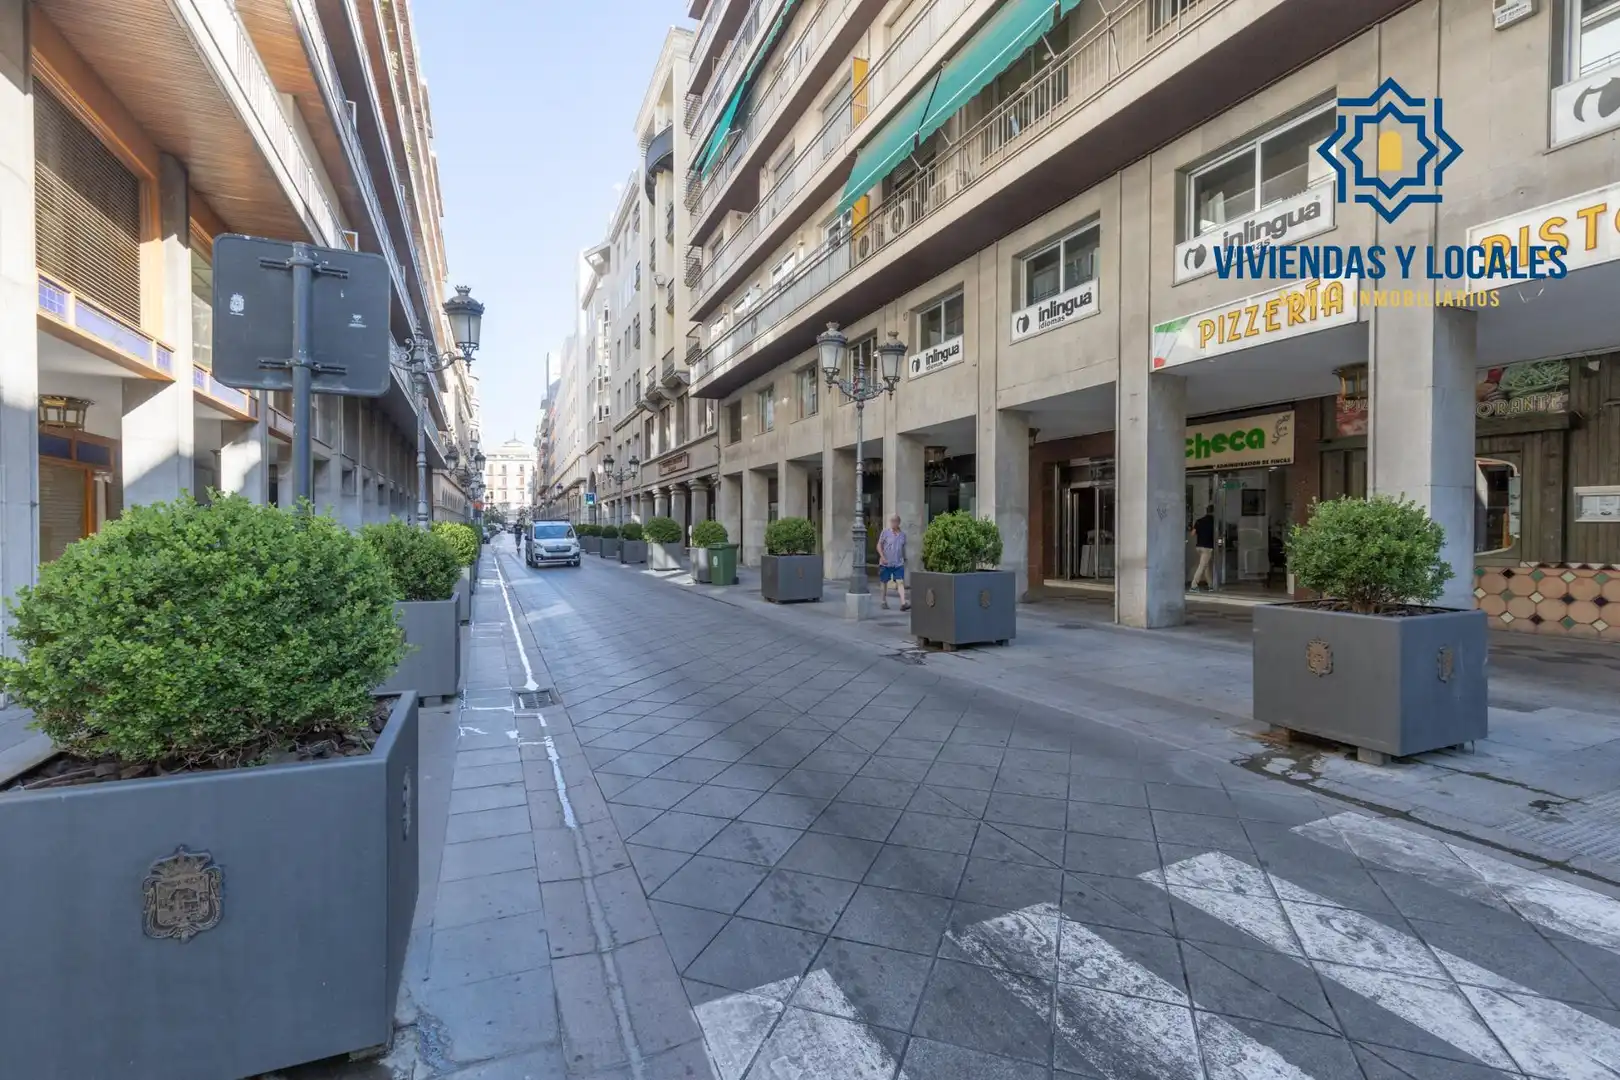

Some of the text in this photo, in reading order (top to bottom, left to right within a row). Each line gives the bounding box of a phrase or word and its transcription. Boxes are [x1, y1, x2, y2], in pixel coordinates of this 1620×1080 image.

[1223, 201, 1321, 250] inlingua
[1480, 202, 1620, 276] RIST
[1038, 291, 1092, 322] inlingua
[1038, 315, 1066, 330] idiomas
[1197, 278, 1344, 349] PIZZERÍA
[925, 344, 960, 366] inlingua
